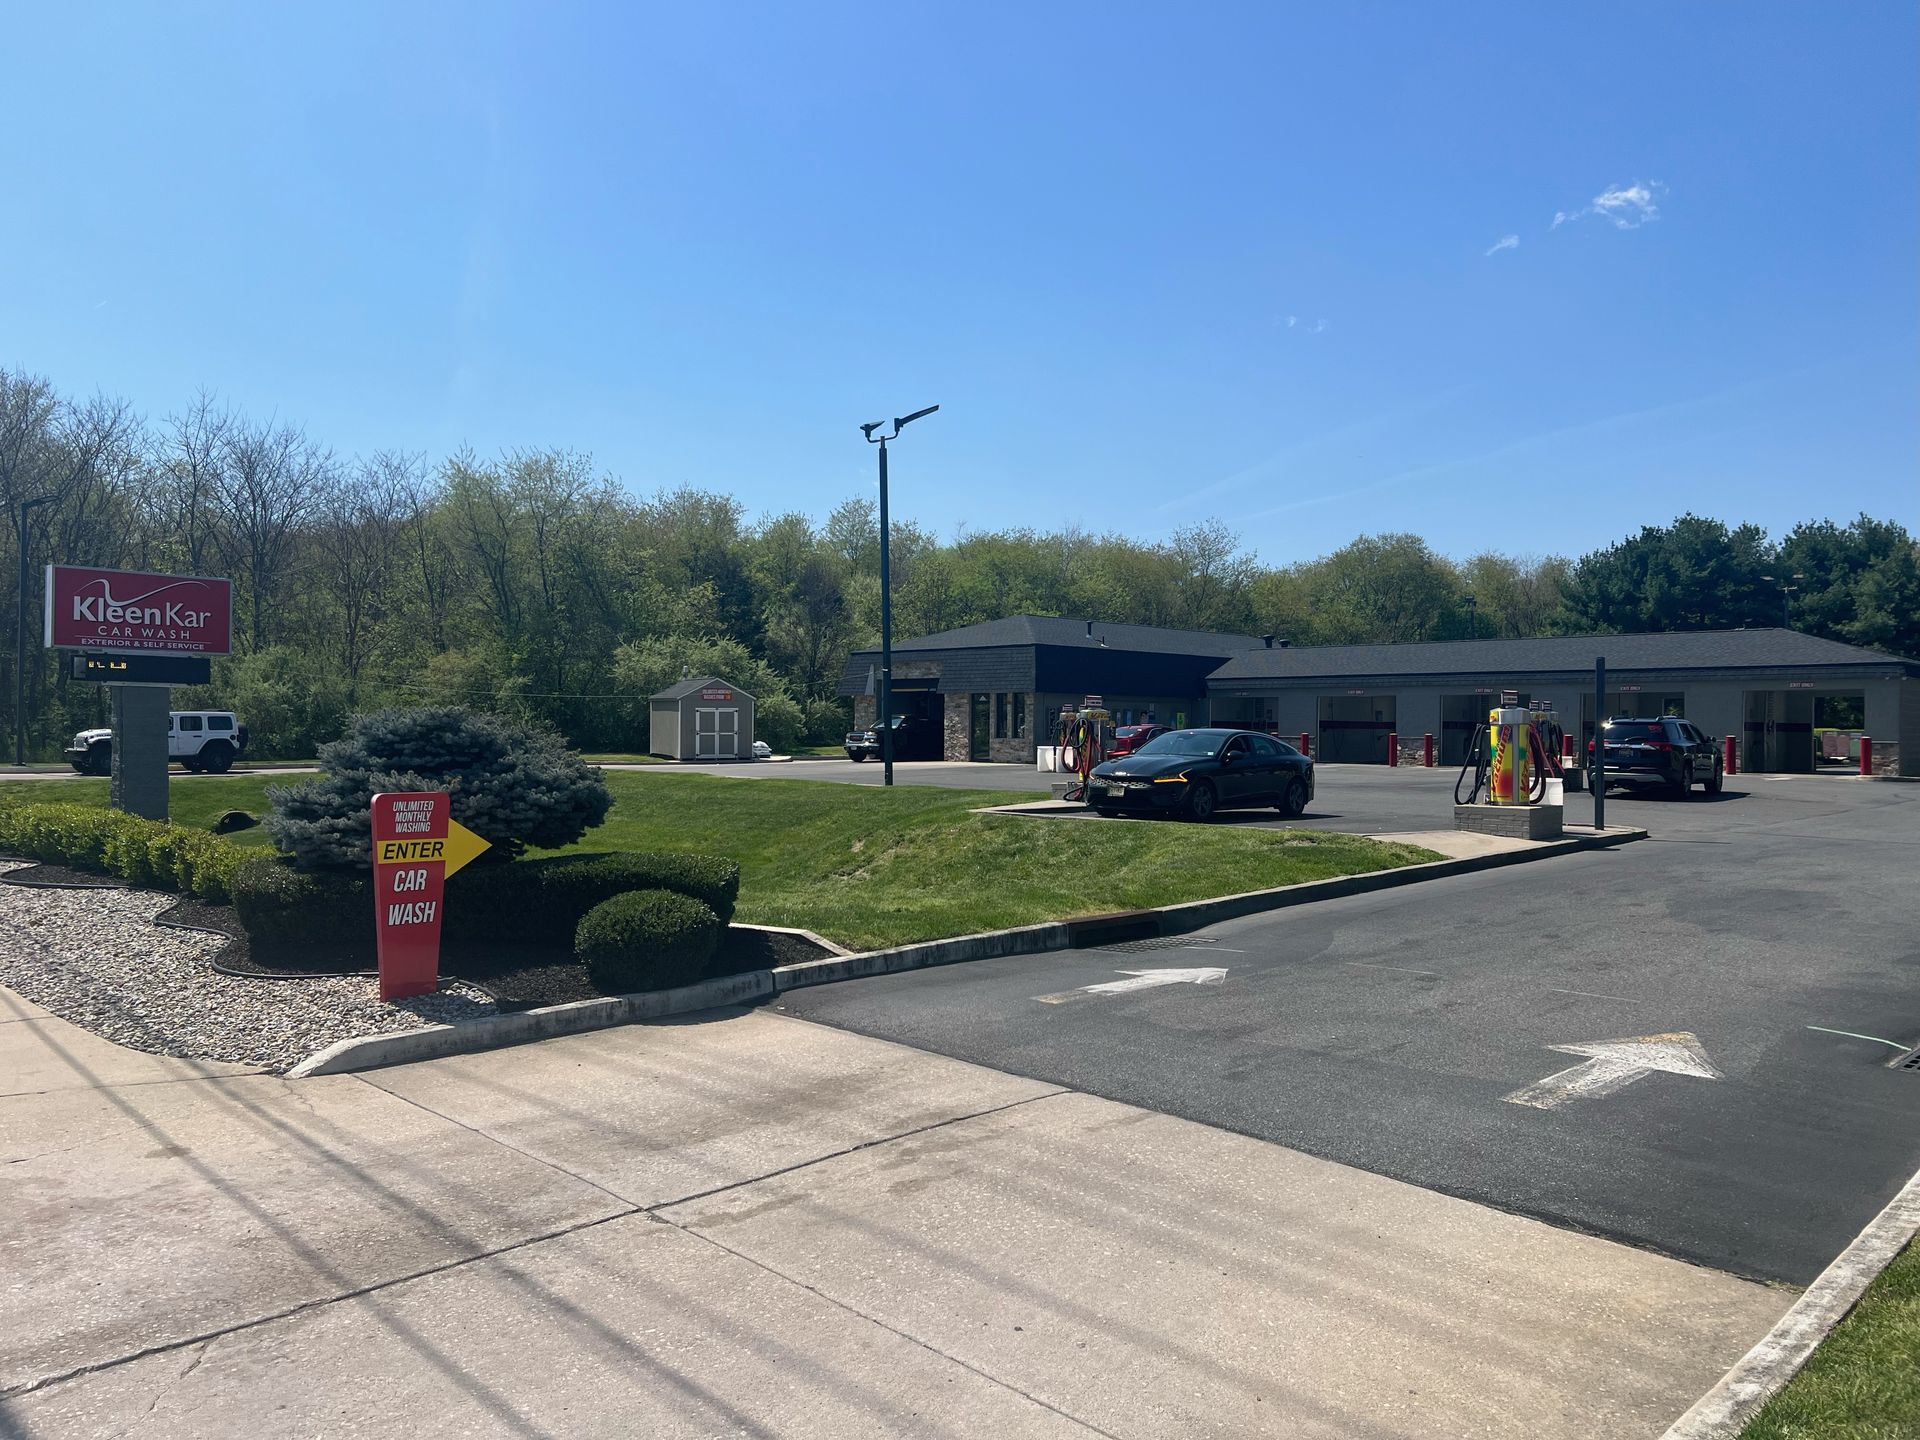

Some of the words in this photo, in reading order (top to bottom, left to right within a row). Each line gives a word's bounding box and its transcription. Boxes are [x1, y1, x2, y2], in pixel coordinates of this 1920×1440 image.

[73, 595, 212, 628] KleenKar
[97, 625, 133, 637] CAR
[141, 627, 190, 640] WASH
[81, 638, 131, 648] EXTERIOR
[143, 641, 166, 649] SELF
[168, 642, 205, 650] SERVICE
[392, 800, 435, 812] UNLIMITED
[394, 811, 432, 823] MONTHLY
[395, 821, 431, 833] WASHING
[383, 841, 444, 860] ENTER
[393, 869, 428, 893] CAR
[388, 901, 437, 926] WASH
